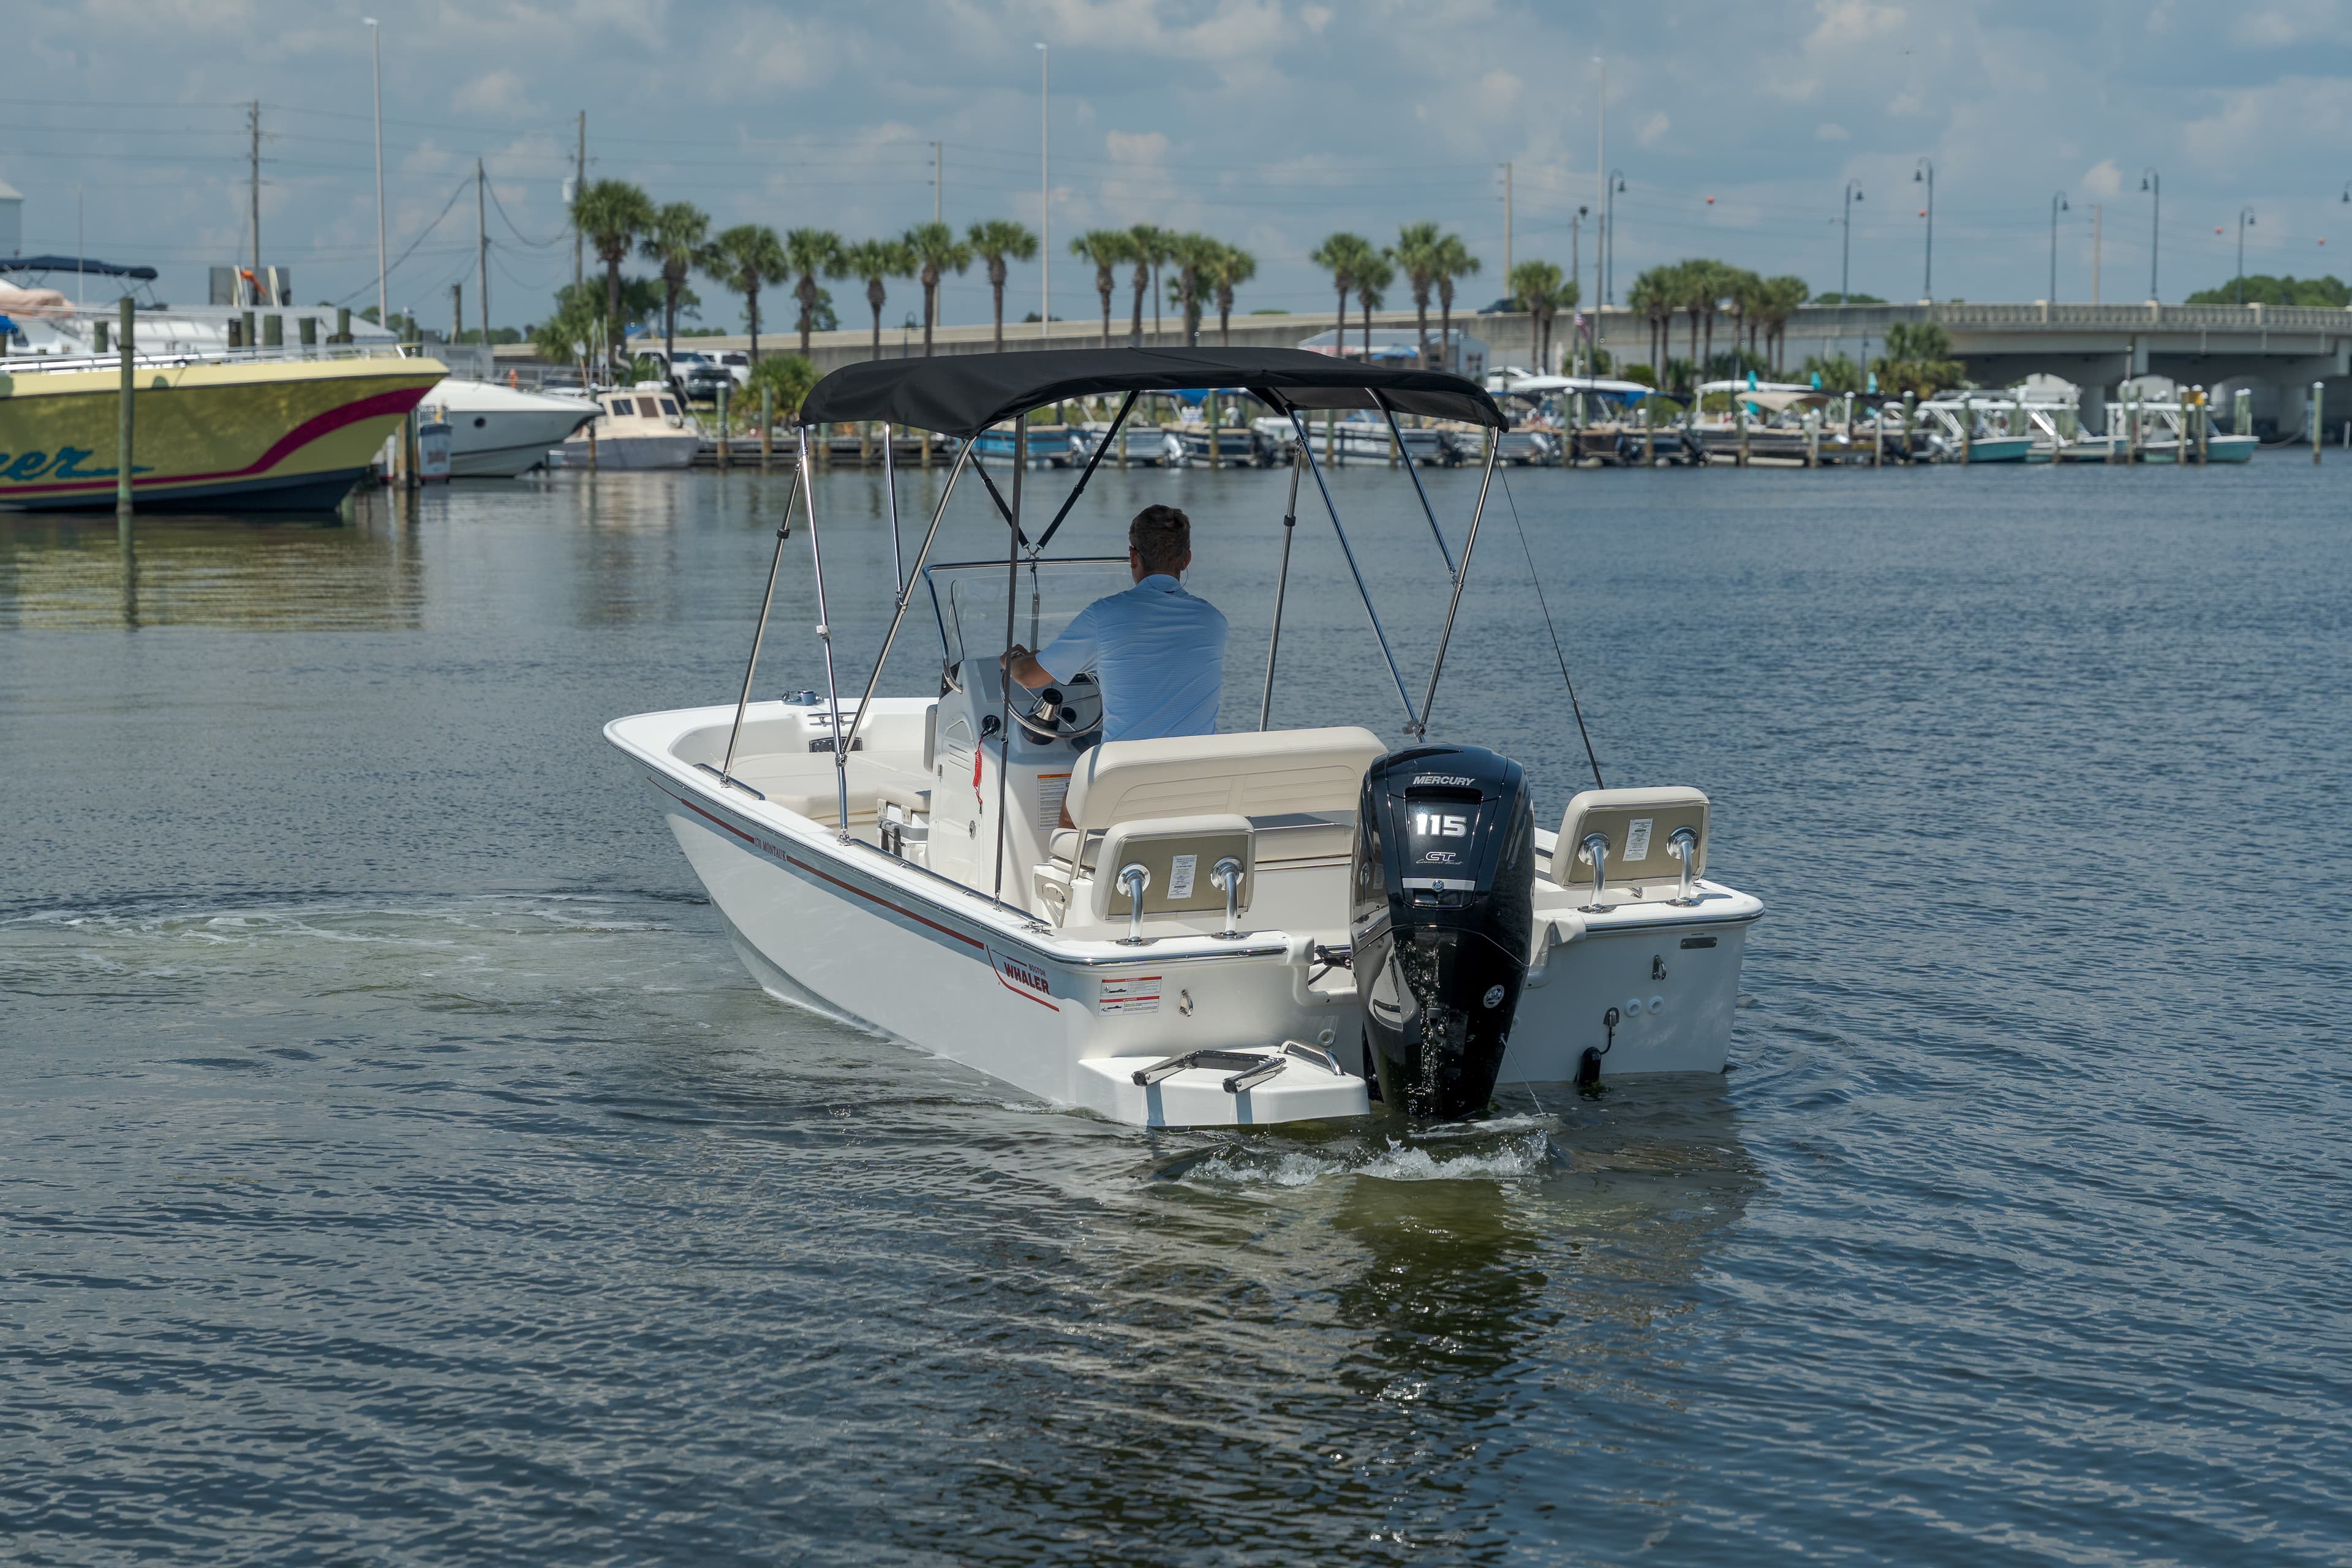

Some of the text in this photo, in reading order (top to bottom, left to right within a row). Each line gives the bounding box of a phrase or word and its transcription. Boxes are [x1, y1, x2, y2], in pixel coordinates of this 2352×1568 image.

[0, 446, 154, 480] er
[1412, 775, 1476, 786] MERCURY
[1415, 813, 1467, 838] 115
[762, 839, 786, 862] MONTAUK
[1003, 961, 1050, 995] WHALER
[1028, 963, 1046, 977] BOSTON
